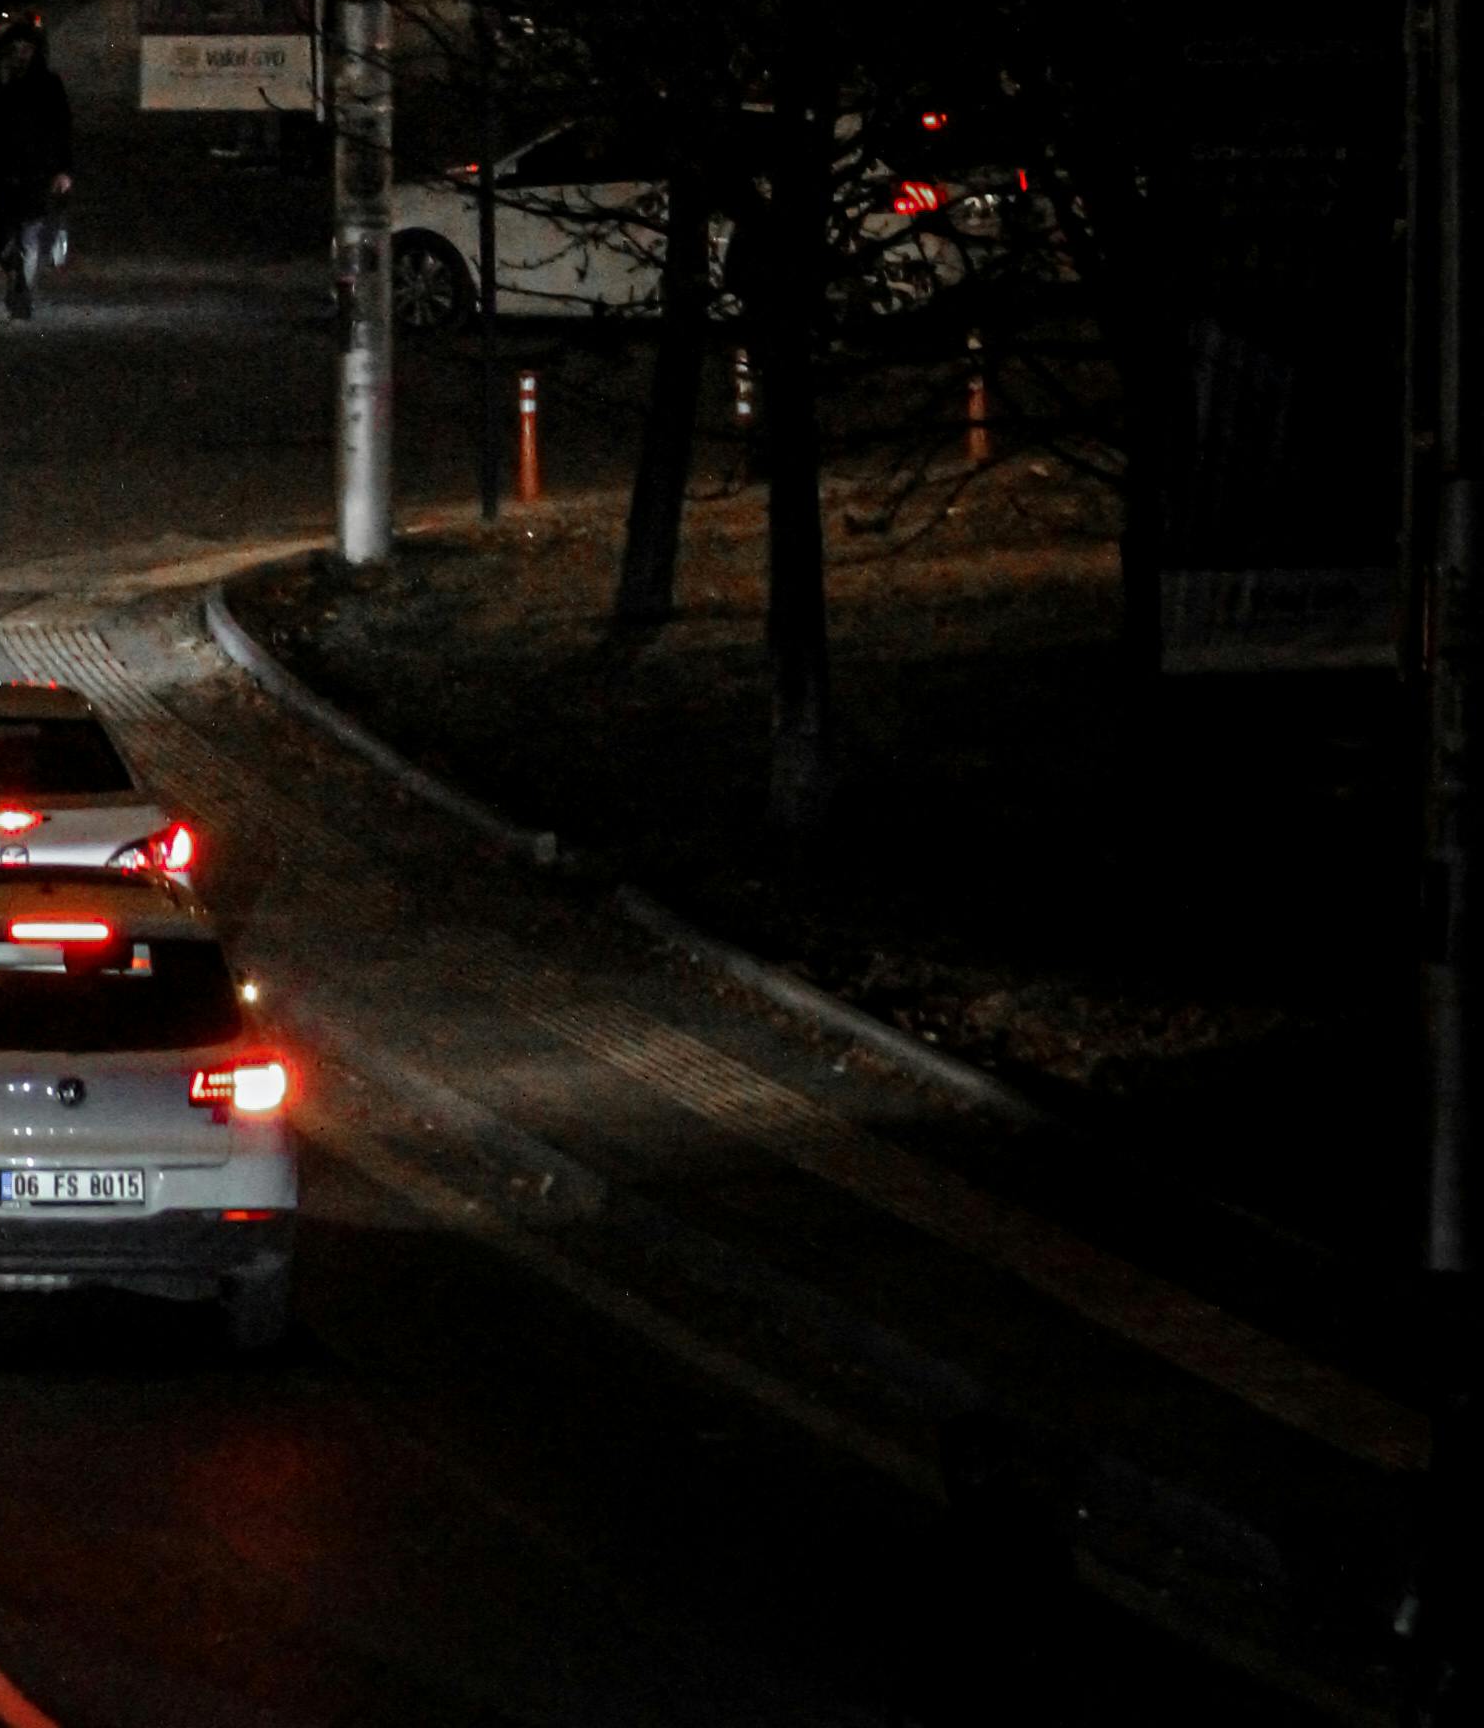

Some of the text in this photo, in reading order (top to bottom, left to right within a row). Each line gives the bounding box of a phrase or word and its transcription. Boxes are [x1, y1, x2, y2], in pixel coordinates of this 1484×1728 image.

[14, 1174, 140, 1198] 06 FS 8015
